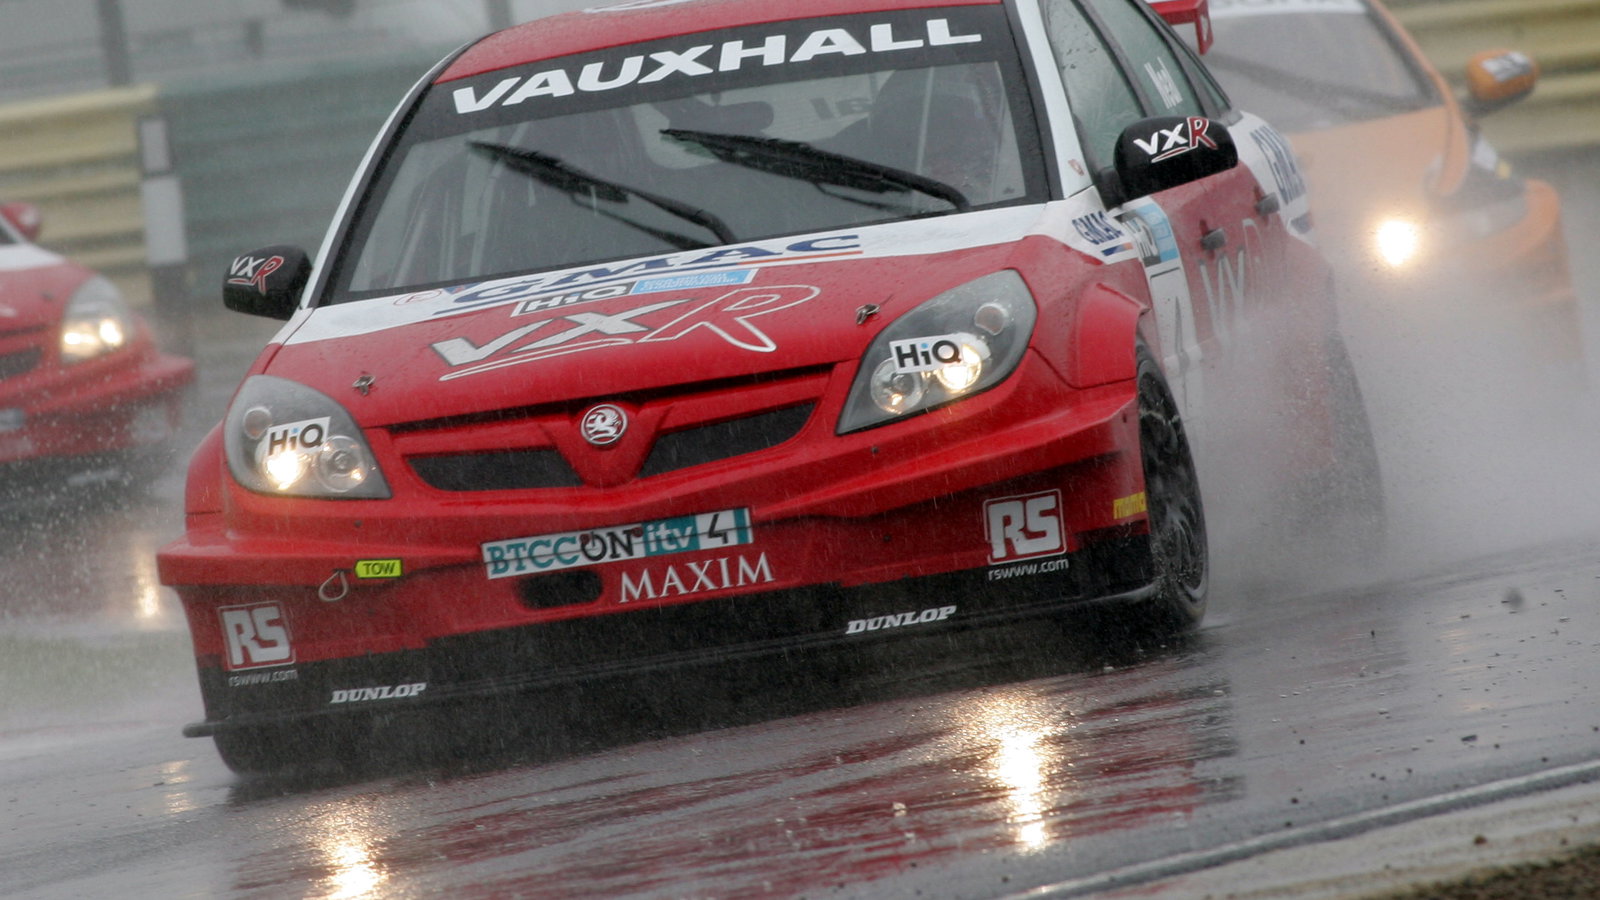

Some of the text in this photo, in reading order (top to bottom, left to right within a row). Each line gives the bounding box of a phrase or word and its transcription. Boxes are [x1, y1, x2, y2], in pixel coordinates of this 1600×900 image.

[453, 18, 982, 114] VAUXHALL
[1133, 116, 1219, 156] VXR
[229, 255, 285, 297] VXR
[453, 233, 860, 304] GMAC
[523, 282, 631, 313] HiQ
[430, 284, 821, 368] VXR
[895, 339, 963, 368] HiQ
[268, 423, 325, 455] HiQ
[646, 523, 696, 553] itv
[707, 512, 730, 545] 4
[987, 494, 1062, 559] RS
[362, 561, 396, 576] TOW
[618, 551, 776, 604] MAXIM
[987, 557, 1070, 582] rswww.com
[222, 605, 291, 666] RS
[845, 604, 957, 635] DUNLOP
[228, 668, 298, 688] rswww.com
[330, 682, 428, 704] DUNLOP
